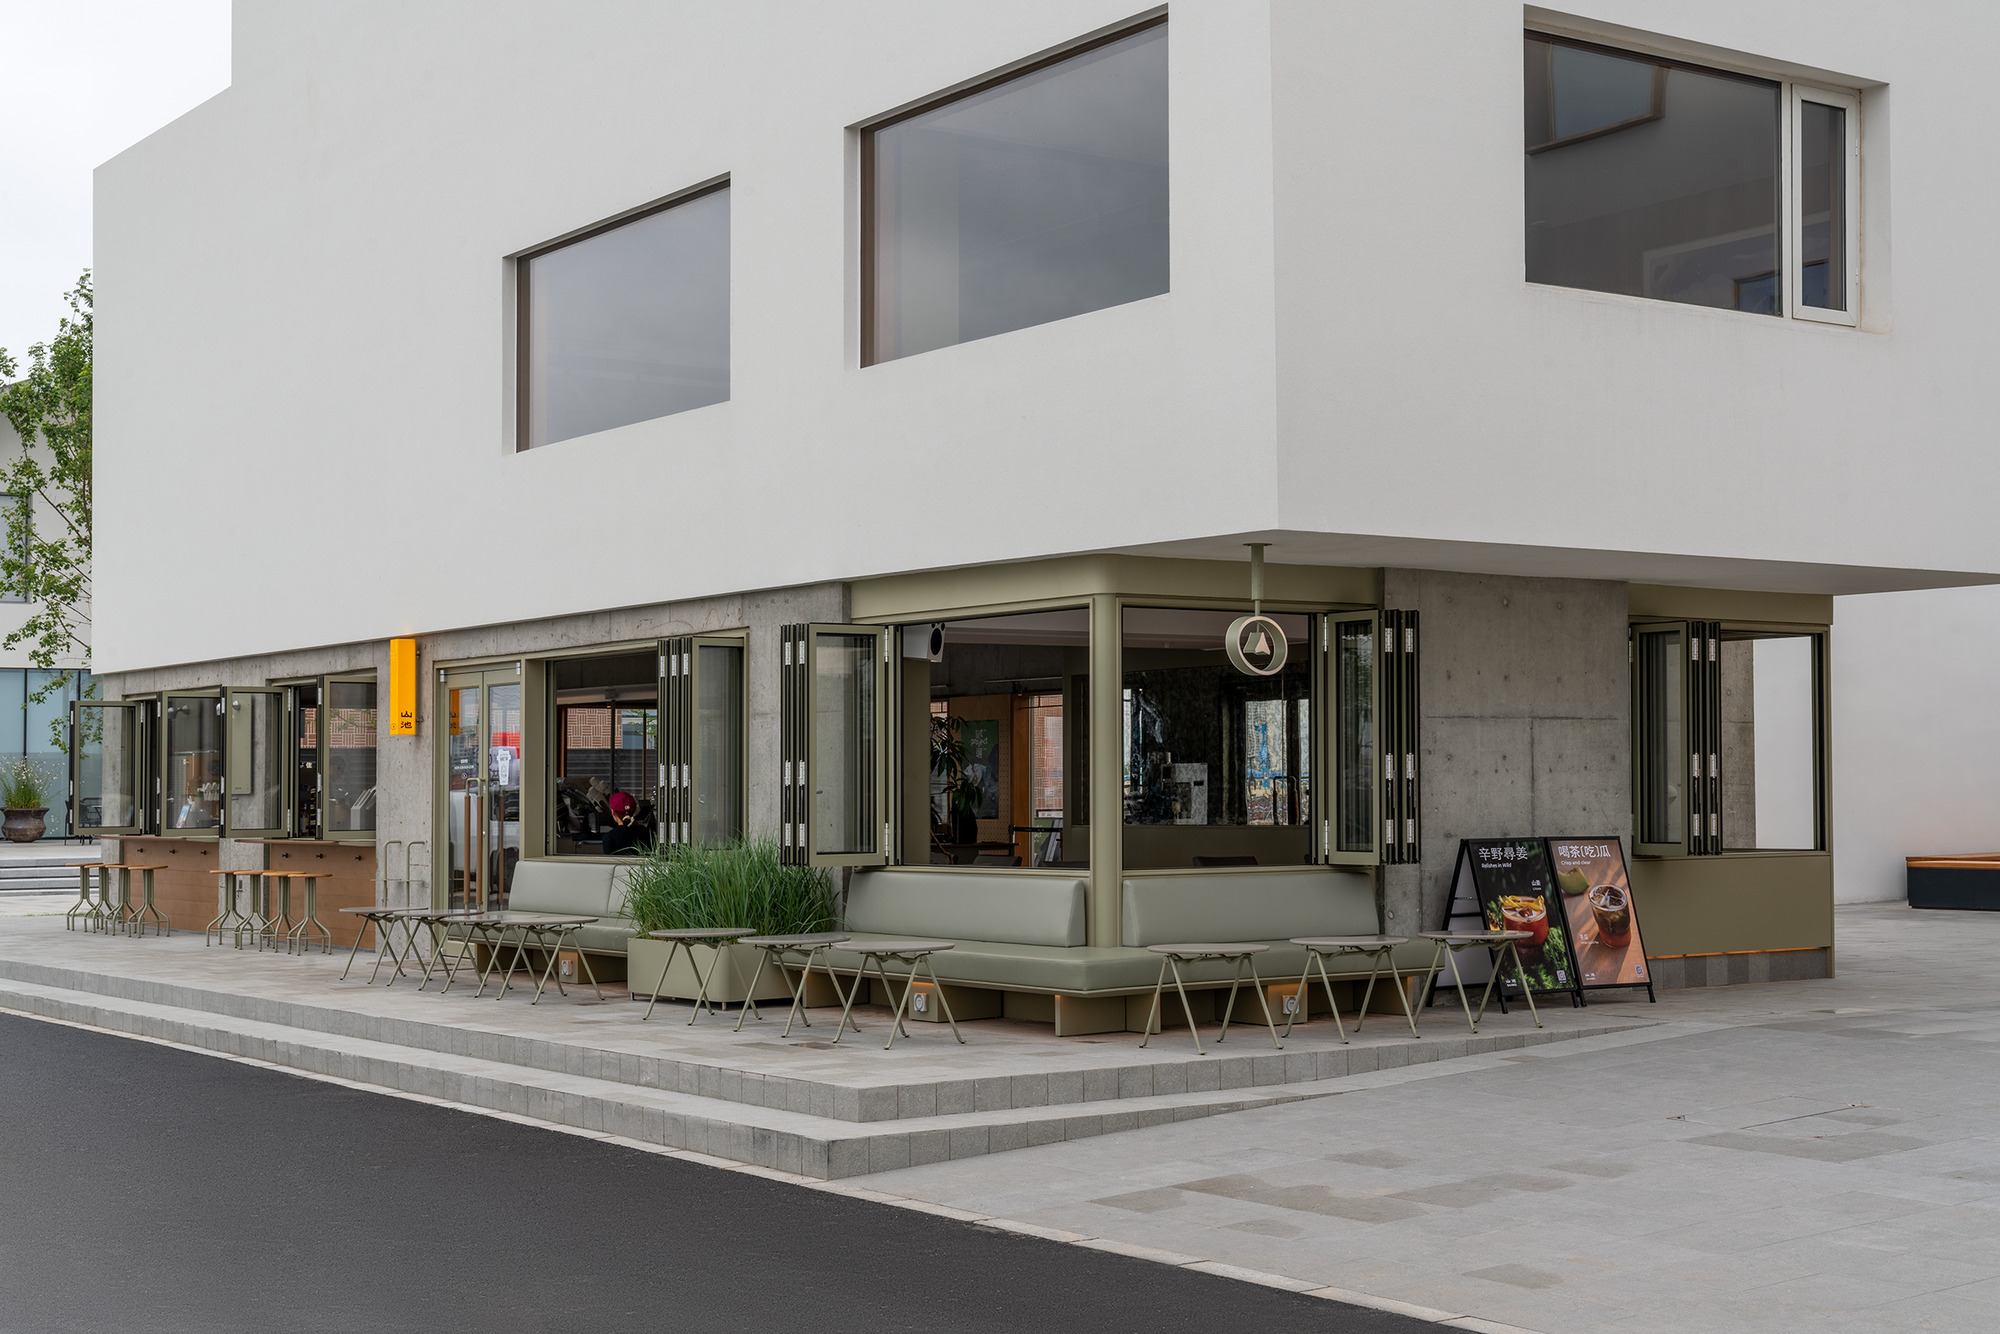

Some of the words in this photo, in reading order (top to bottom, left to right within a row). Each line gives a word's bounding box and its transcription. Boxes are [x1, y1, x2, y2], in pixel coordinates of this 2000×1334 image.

[401, 711, 412, 729] 山池
[1479, 846, 1528, 861] 辛野尋姜
